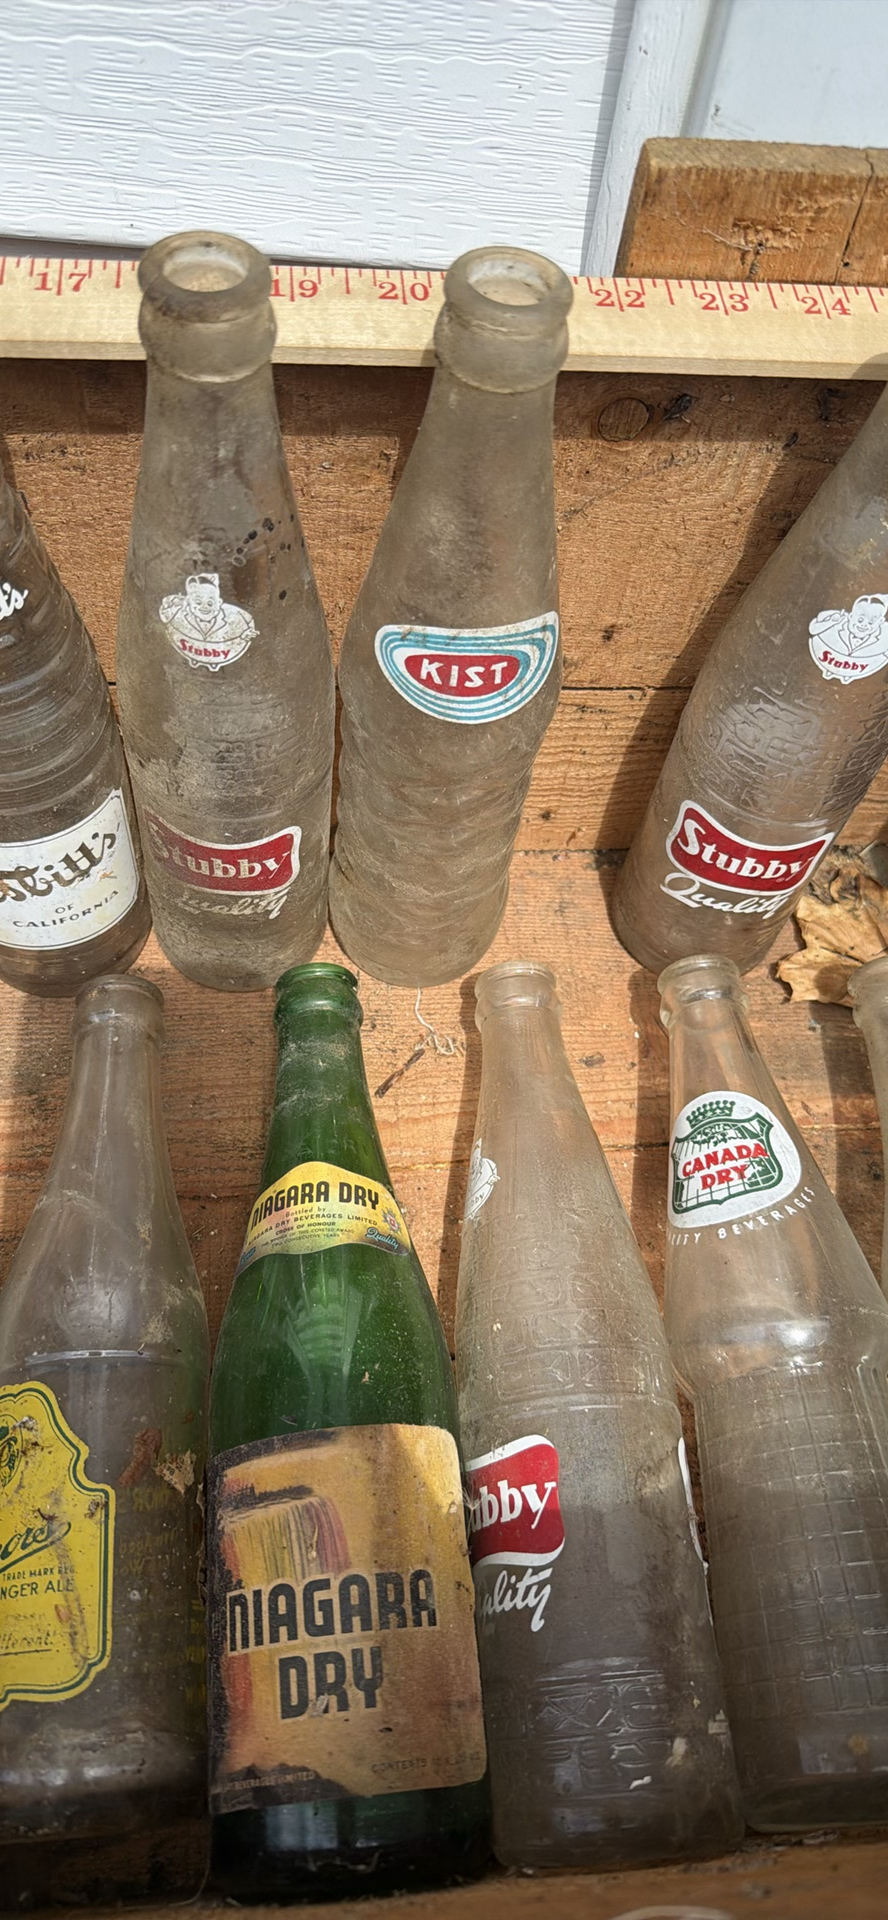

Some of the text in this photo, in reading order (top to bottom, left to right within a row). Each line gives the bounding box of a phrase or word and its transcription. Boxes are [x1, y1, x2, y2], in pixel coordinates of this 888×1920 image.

[379, 281, 430, 301] 20
[595, 289, 645, 309] 22
[701, 293, 750, 313] 23
[801, 295, 851, 316] 24
[180, 639, 231, 659] Stubby
[818, 650, 869, 673] Stubby
[420, 658, 508, 688] KIST
[148, 820, 291, 879] Stubby
[677, 818, 814, 882] Stubby
[13, 890, 118, 927] CALIFORNIA
[55, 903, 74, 914] OF
[659, 872, 791, 920] Quality
[682, 1142, 770, 1178] CANADA
[700, 1163, 749, 1190] DRY
[251, 1181, 379, 1231] NIAGARA DRY
[275, 1219, 291, 1228] DRY
[294, 1213, 343, 1222] BEVERAGES
[347, 1214, 378, 1226] LIMITED
[285, 1205, 327, 1218] Bottled by
[718, 1186, 815, 1239] BEVERAGES
[275, 1226, 294, 1236] CROSS
[365, 1226, 399, 1250] Quality
[3, 1571, 26, 1582] TRADE
[29, 1567, 55, 1578] MARK
[44, 1579, 74, 1594] ALE
[228, 1569, 438, 1653] NIAGARA
[279, 1646, 383, 1720] DRY
